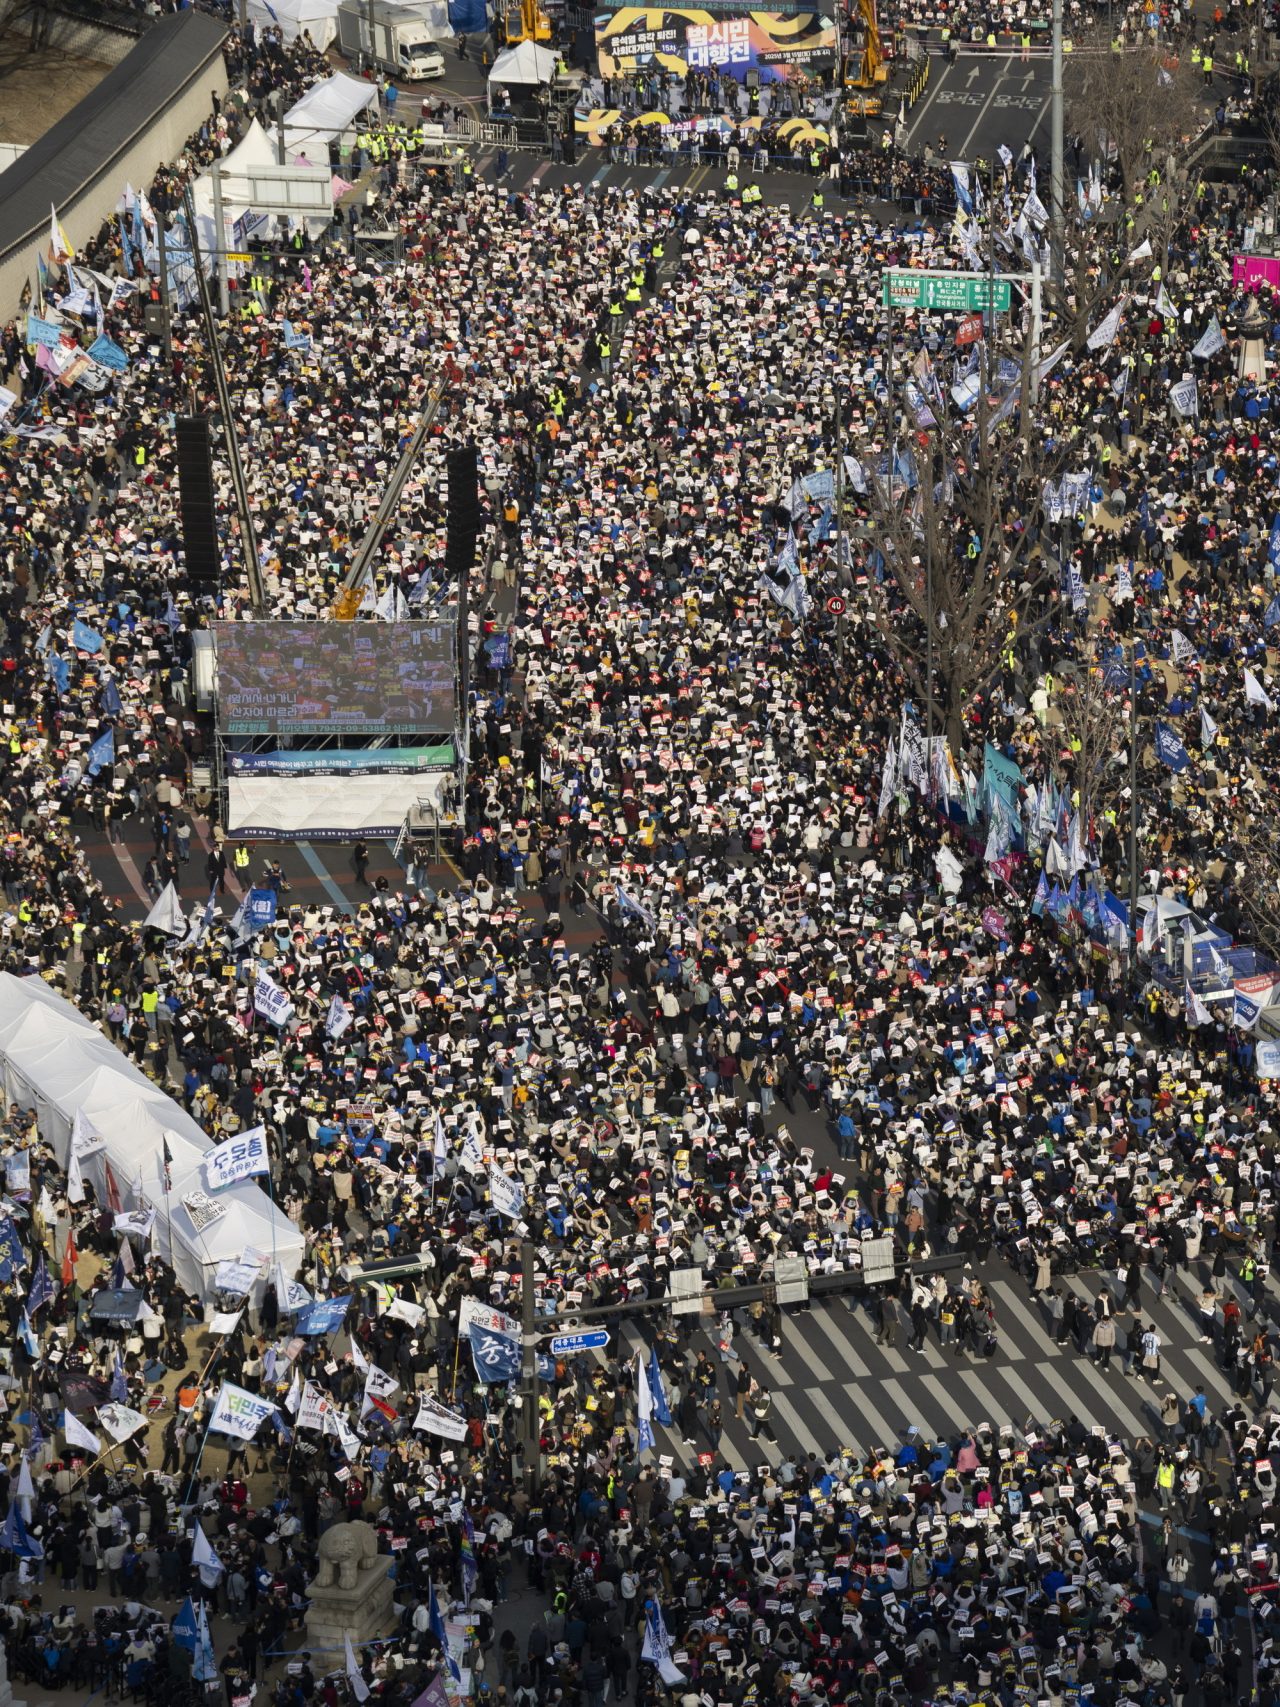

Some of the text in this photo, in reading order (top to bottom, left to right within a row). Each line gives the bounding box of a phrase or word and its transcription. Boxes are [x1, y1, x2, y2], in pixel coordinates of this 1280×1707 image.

[687, 19, 750, 44] 범시민
[611, 29, 677, 47] 윤석열 즉각 퇴진!
[611, 44, 656, 57] 사회대개혁!
[661, 46, 677, 54] 15차
[687, 42, 750, 67] 대행진
[821, 49, 831, 57] 4시
[936, 90, 985, 106] 율곡로
[993, 94, 1043, 109] 율곡로
[831, 601, 842, 610] 40
[266, 693, 297, 704] 나가니
[231, 706, 297, 717] 산자여 따르라
[277, 724, 318, 732] 카카오뱅크
[318, 724, 392, 732] 7942-09-53862
[555, 1336, 584, 1347] 세종대로
[554, 1344, 587, 1352] Sejong-daero
